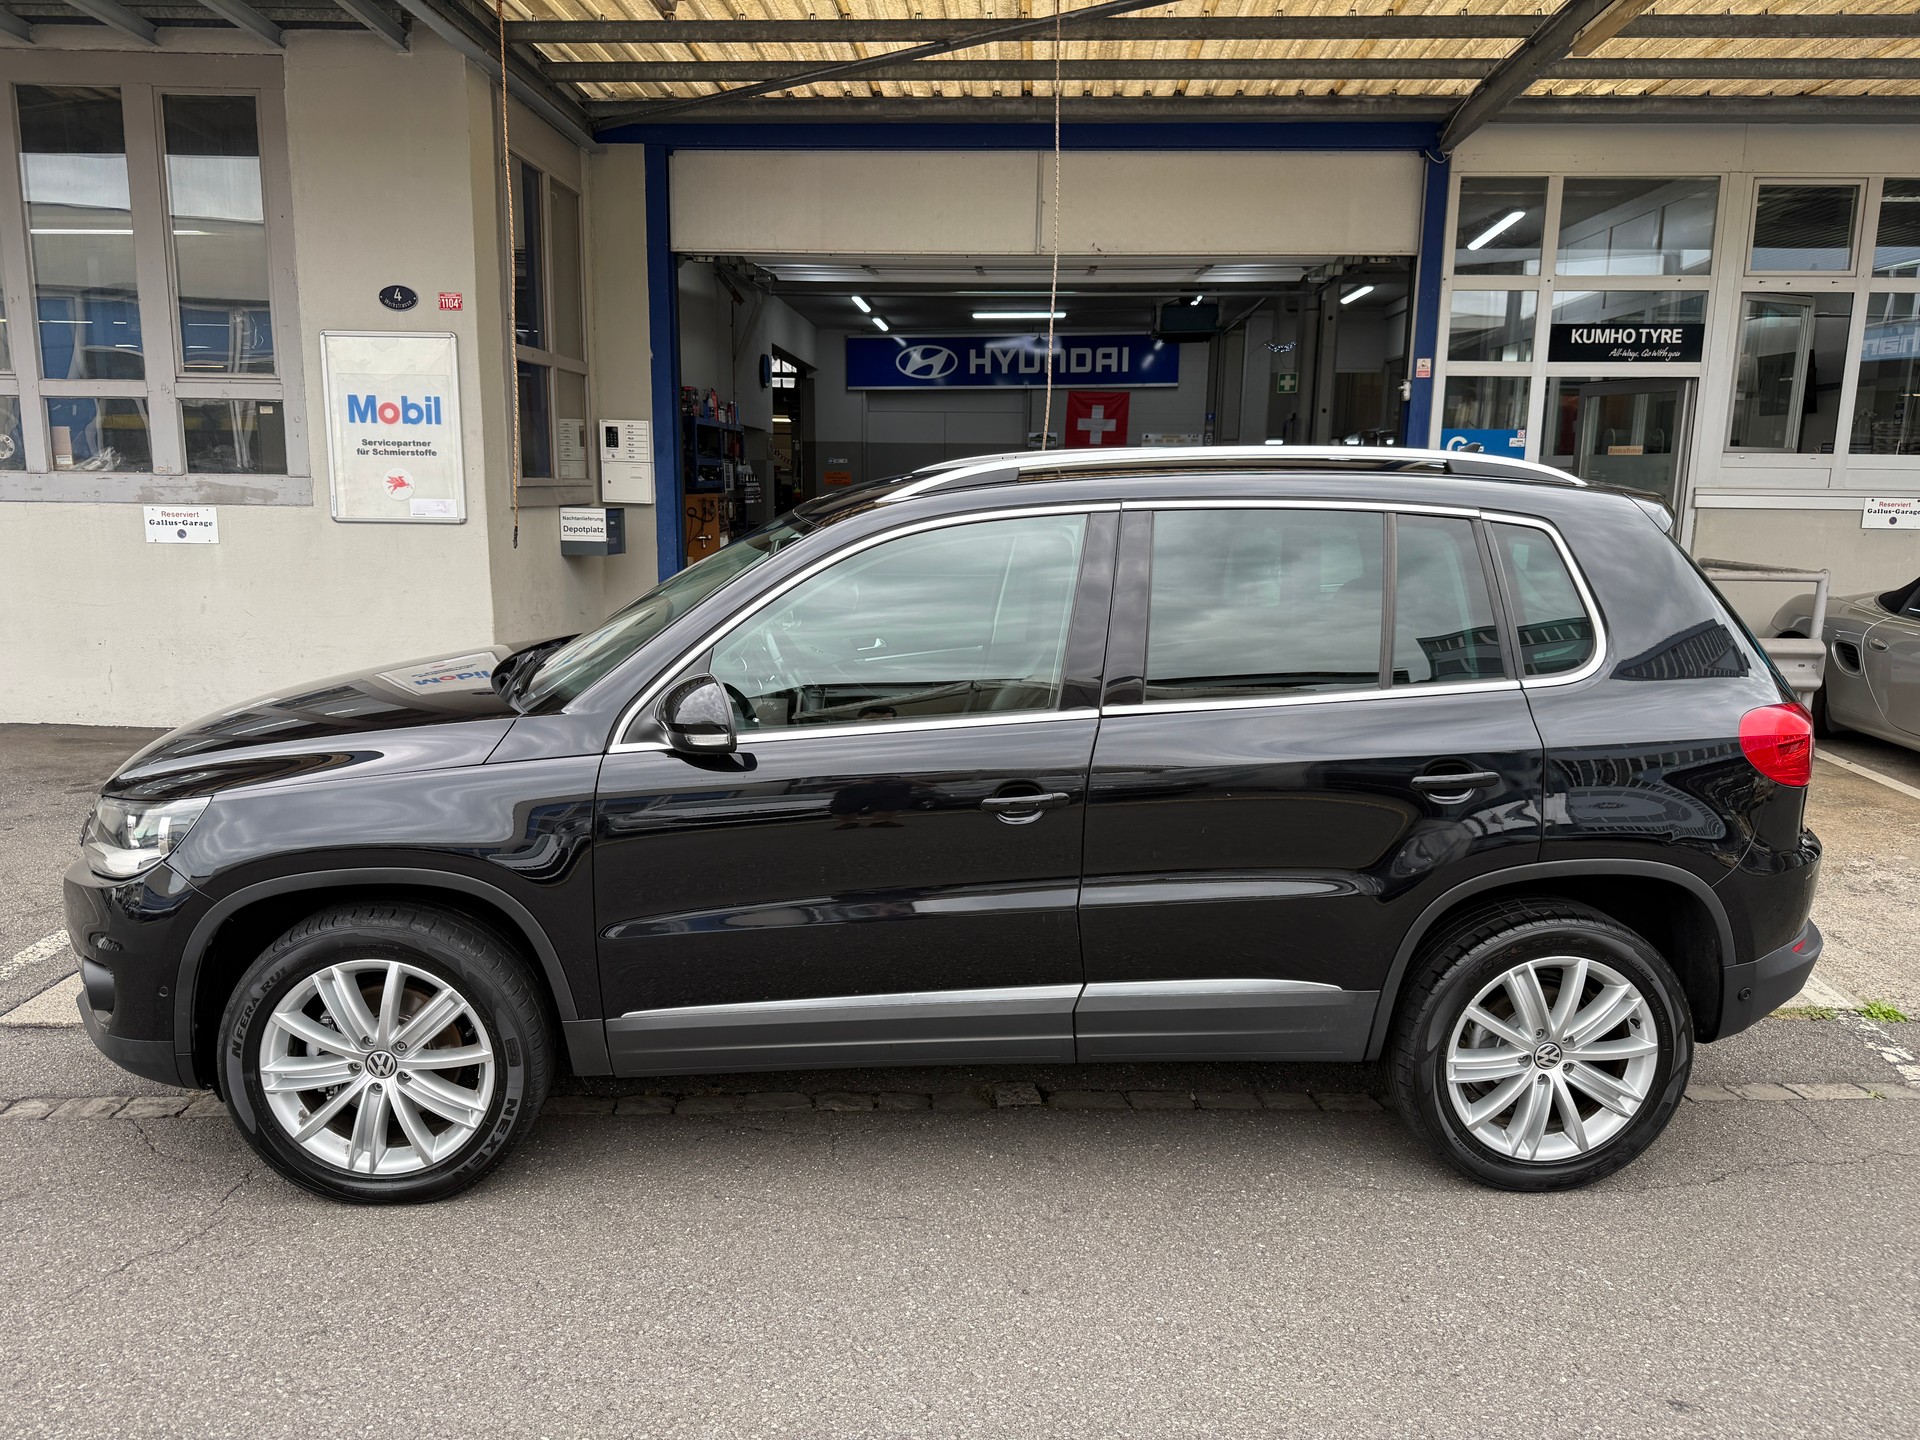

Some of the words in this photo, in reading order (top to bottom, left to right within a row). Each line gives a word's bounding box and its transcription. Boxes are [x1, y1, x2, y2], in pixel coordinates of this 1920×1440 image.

[393, 287, 402, 301] 4
[441, 298, 459, 308] 1104
[1570, 328, 1636, 344] KUMHO
[1639, 328, 1683, 344] TYRE
[969, 347, 1129, 374] HYUNDAI
[347, 394, 442, 425] Mobil
[361, 438, 431, 448] Servicepartner
[356, 448, 369, 456] für
[372, 448, 437, 457] Schmierstoffe
[161, 510, 200, 518] Reserviert
[562, 515, 604, 523] Nachtanlieferung
[148, 519, 214, 528] Gallus-Garage
[563, 525, 605, 535] Depotplatz
